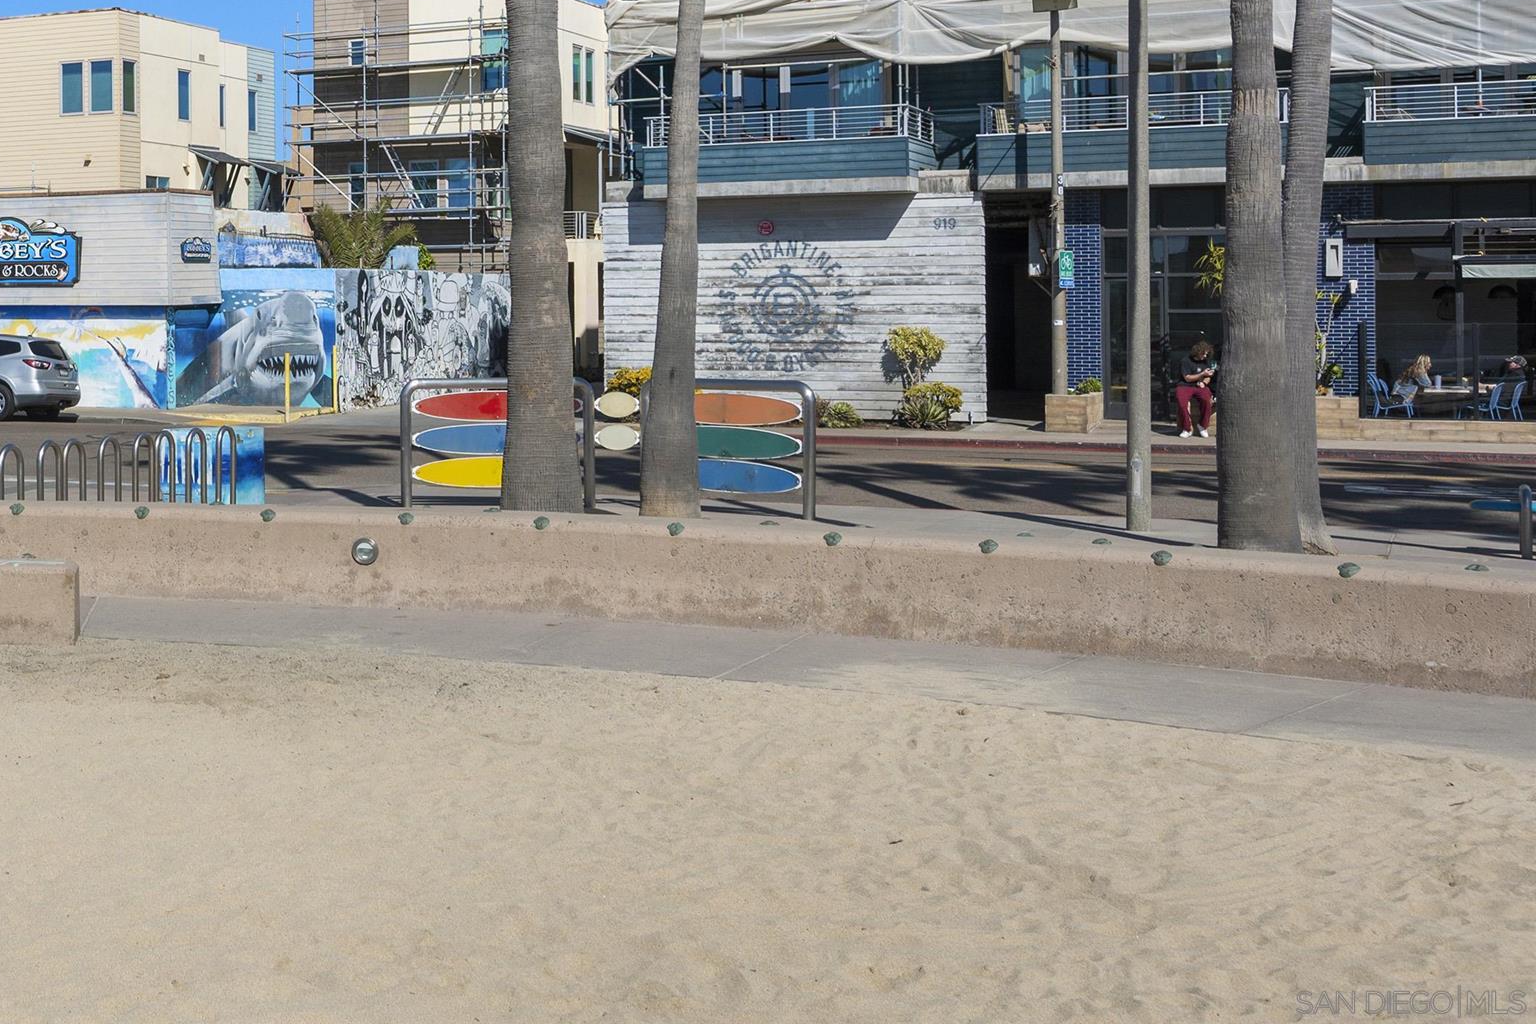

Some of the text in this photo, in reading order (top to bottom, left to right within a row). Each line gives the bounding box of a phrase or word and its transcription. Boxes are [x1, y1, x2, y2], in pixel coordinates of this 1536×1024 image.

[933, 217, 956, 230] 919
[731, 240, 843, 278] BRIGANTINE
[2, 265, 12, 277] &
[14, 264, 59, 277] ROCKS
